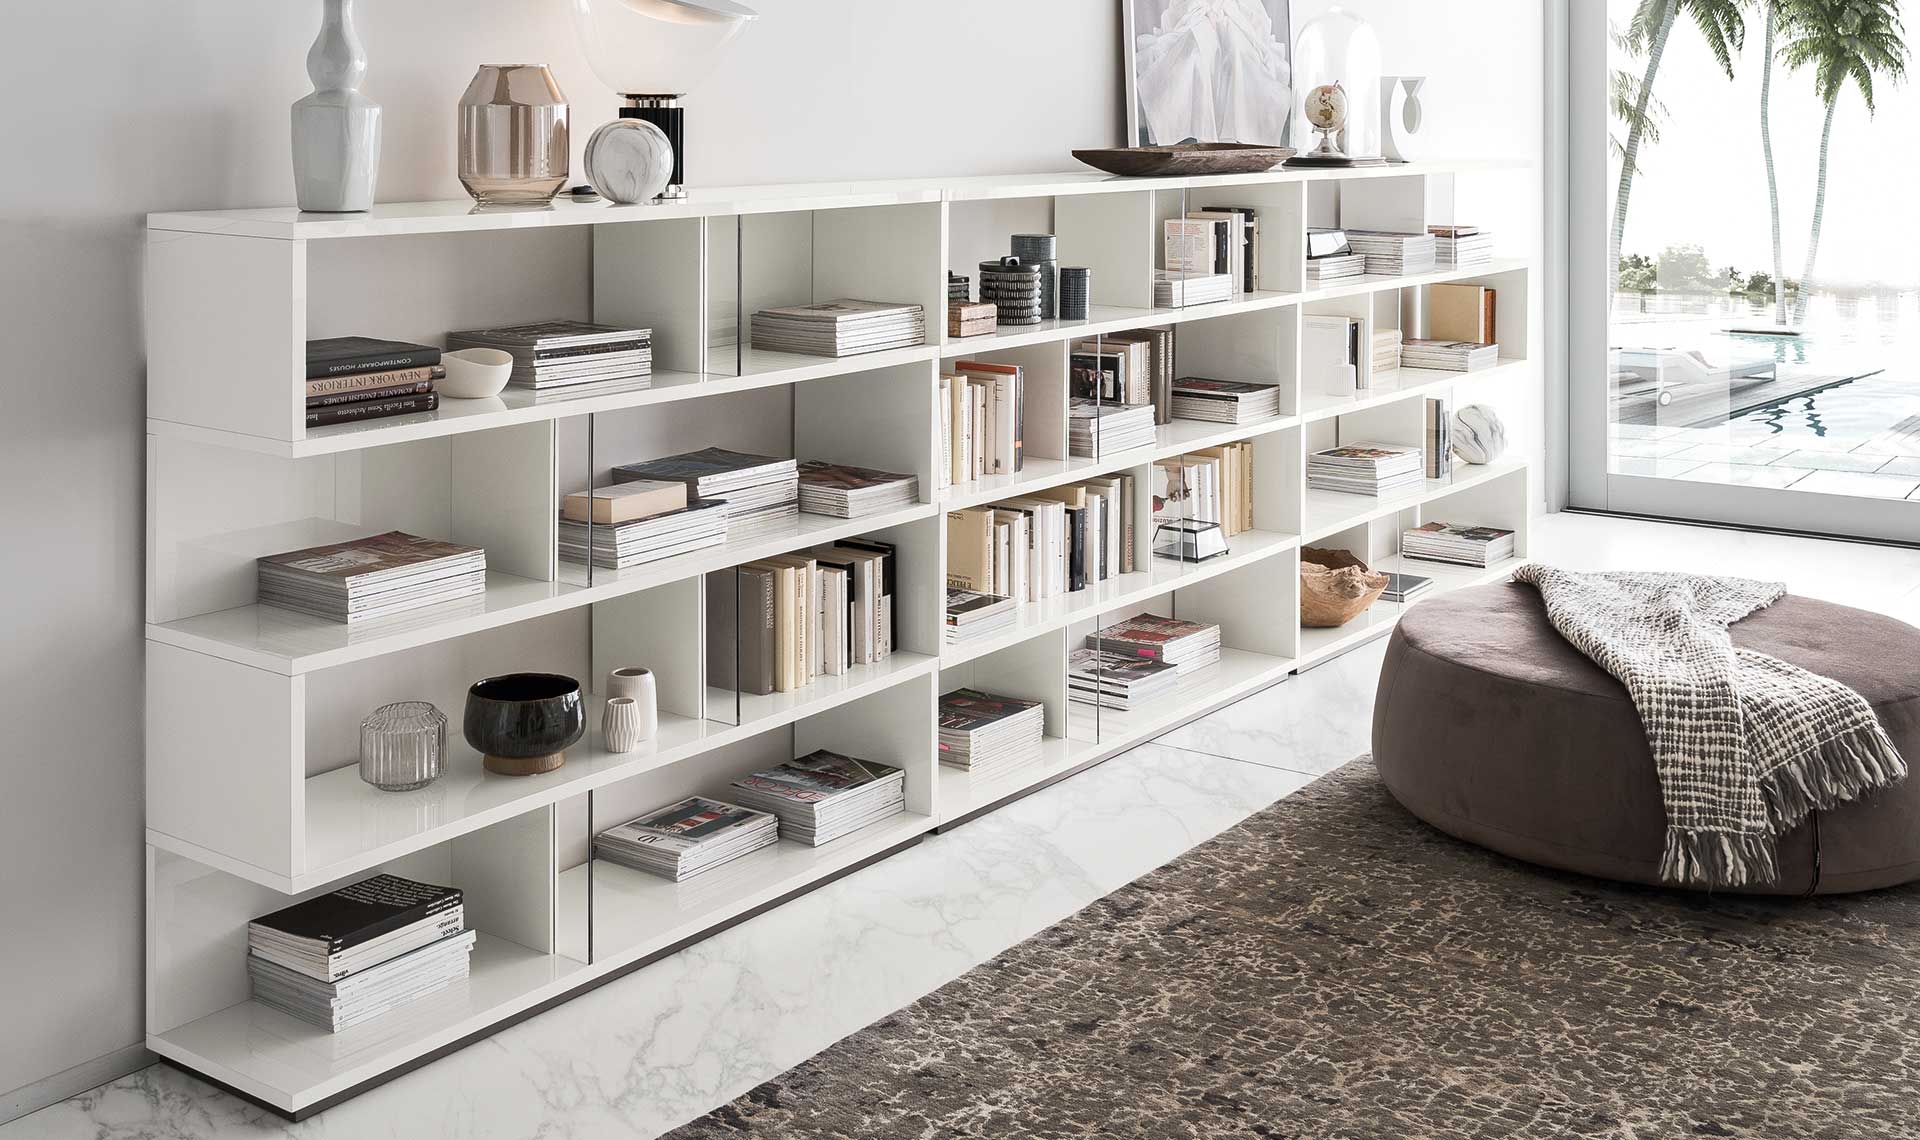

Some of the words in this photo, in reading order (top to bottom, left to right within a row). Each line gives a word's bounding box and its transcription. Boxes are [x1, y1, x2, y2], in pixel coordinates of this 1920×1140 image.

[329, 364, 356, 372] HOUSES
[357, 358, 412, 369] CONTEMPORARY
[369, 373, 397, 385] YORK
[398, 370, 421, 382] NEW
[311, 377, 367, 393] INTERIORS
[348, 391, 377, 402] ENGLISH
[378, 387, 413, 398] ROMANTIC
[323, 396, 347, 405] HOMES
